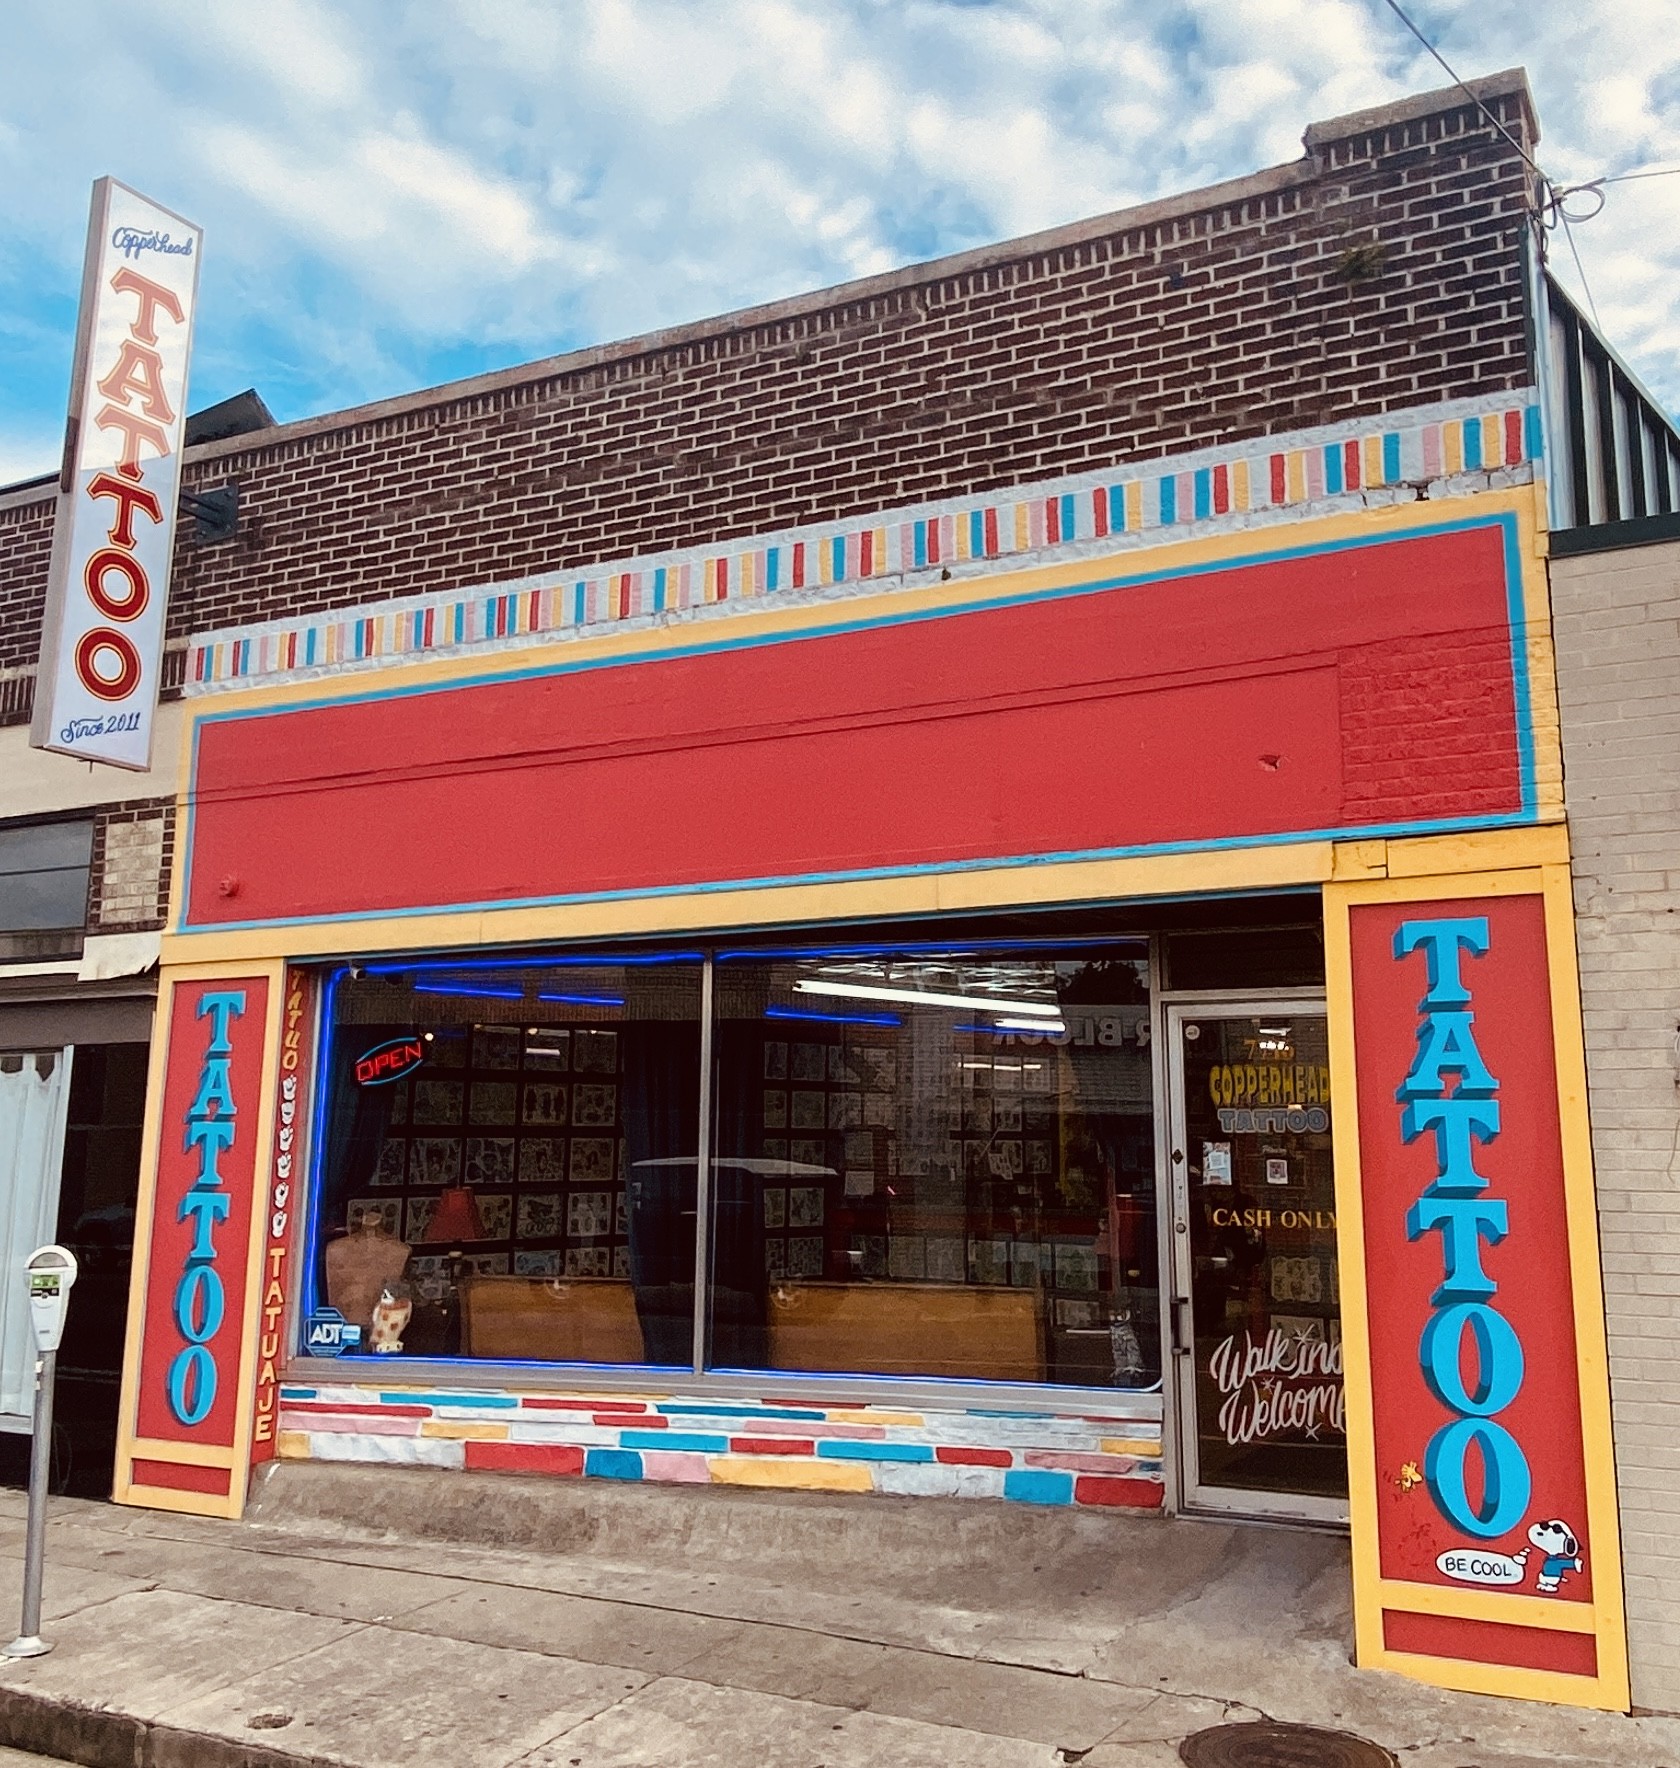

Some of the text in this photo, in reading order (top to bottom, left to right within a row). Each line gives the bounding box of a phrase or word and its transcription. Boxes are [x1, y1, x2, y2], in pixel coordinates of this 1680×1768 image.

[112, 227, 193, 260] Copperhead
[75, 267, 185, 701] TATTOO
[61, 712, 141, 743] Since 2011
[283, 970, 304, 1070] TATUO
[356, 1042, 421, 1081] OPEN
[1209, 1064, 1331, 1109] COPPERHEAD
[1217, 1107, 1329, 1133] TATTOO
[168, 990, 246, 1427] TATTOO
[1212, 1207, 1271, 1227] CASH
[1392, 915, 1531, 1540] TATTOO
[255, 1247, 286, 1442] TATUAJE
[309, 1323, 344, 1344] ADT
[1210, 1329, 1297, 1393] Walk
[1445, 1557, 1512, 1577] BE COOL
